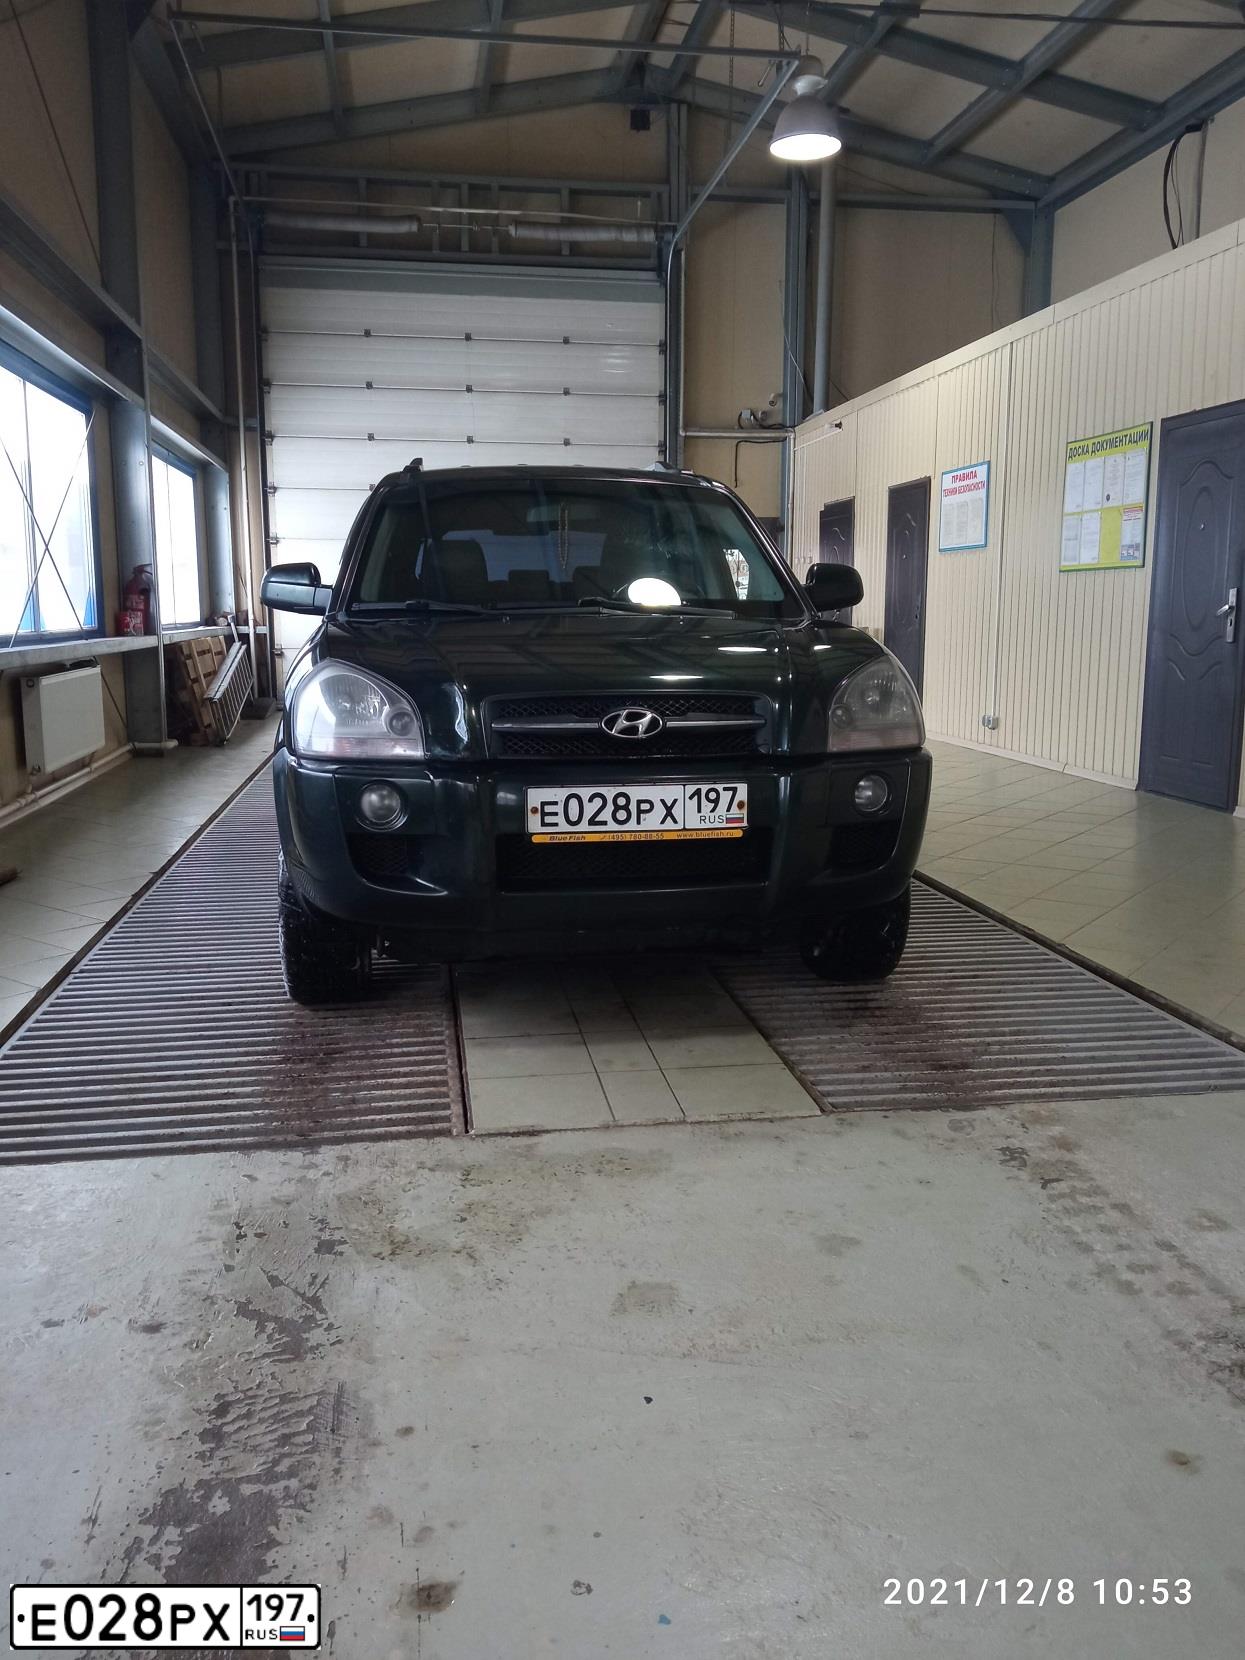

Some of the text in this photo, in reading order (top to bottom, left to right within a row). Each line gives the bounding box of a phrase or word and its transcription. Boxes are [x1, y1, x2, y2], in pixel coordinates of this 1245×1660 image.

[1068, 429, 1149, 461] ДОСКА ДОКУМЕНТАЦИИ
[951, 470, 978, 484] ПРАВИЛА
[688, 786, 738, 813] 197
[699, 815, 725, 824] RUS
[676, 830, 734, 839] www.bluefish.ru
